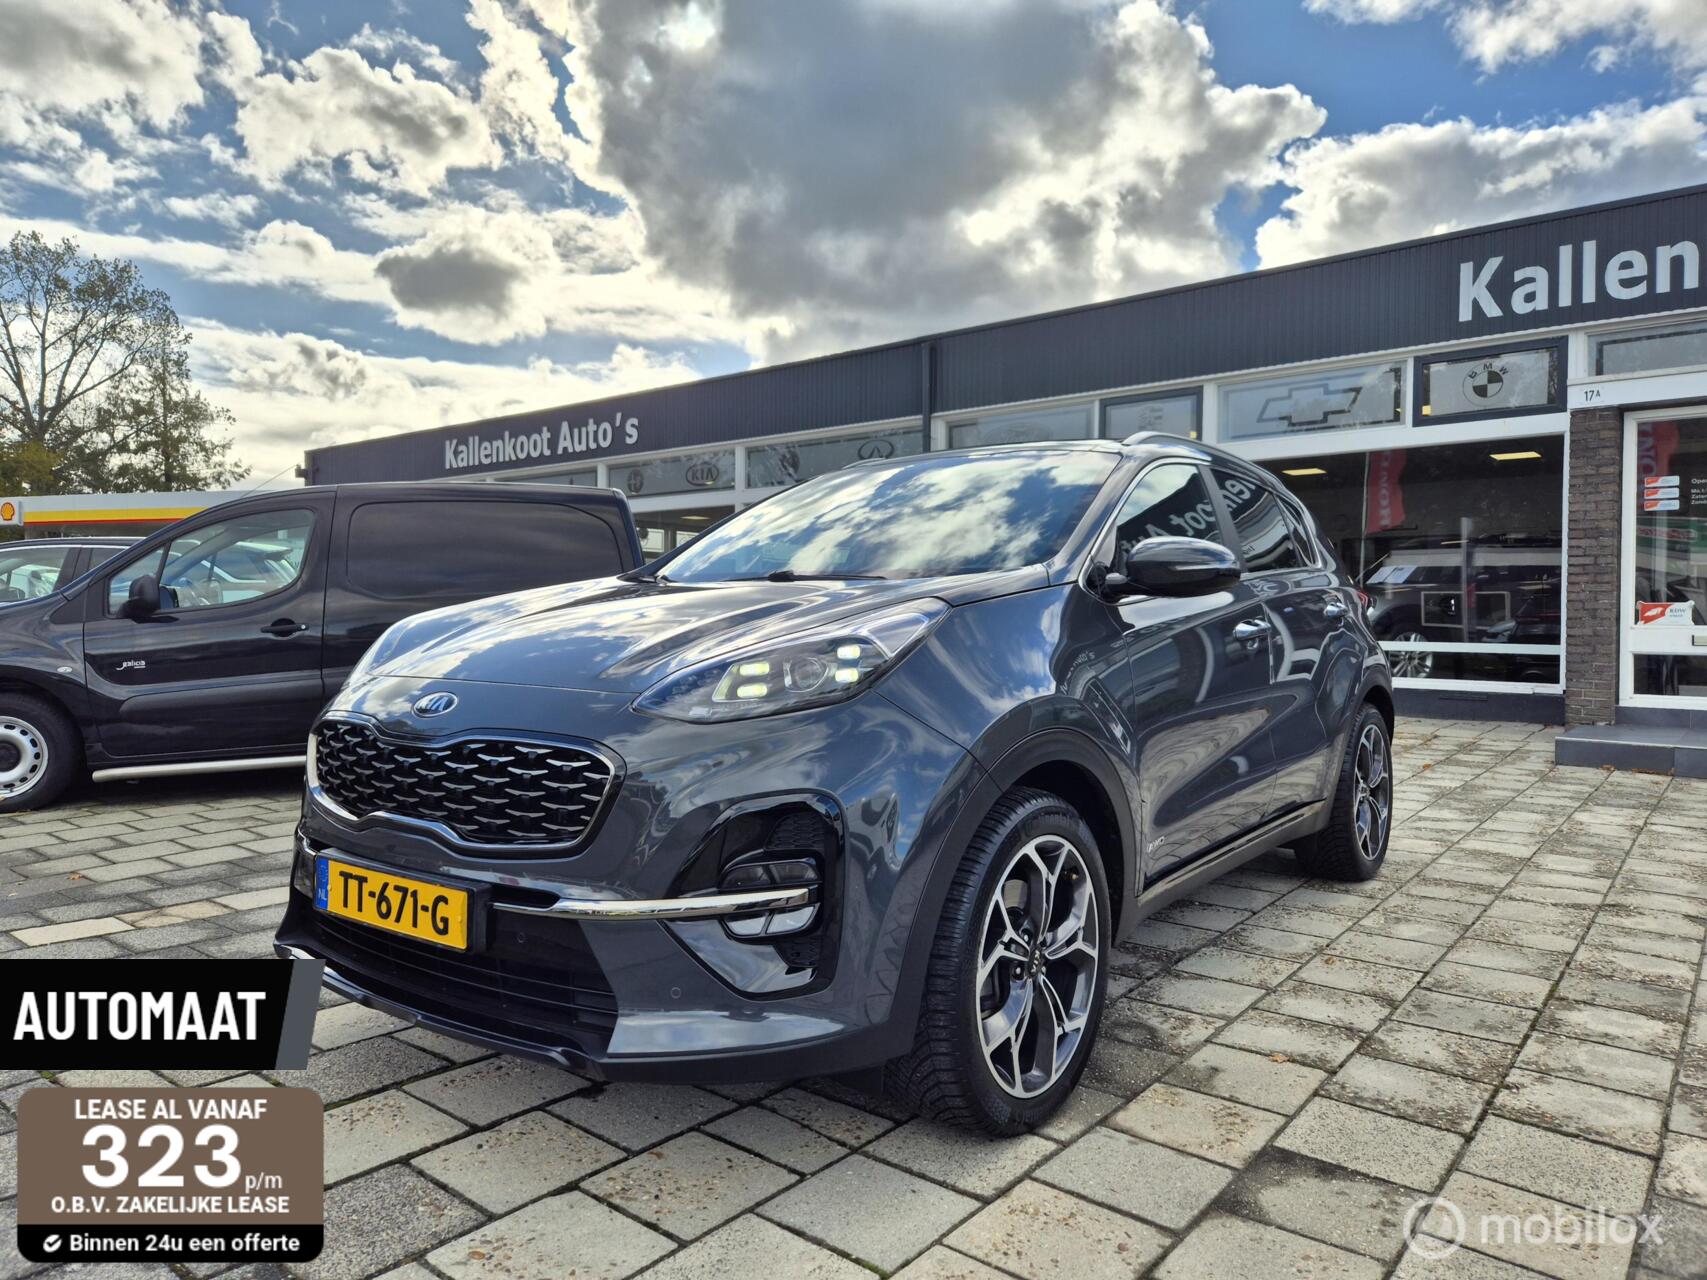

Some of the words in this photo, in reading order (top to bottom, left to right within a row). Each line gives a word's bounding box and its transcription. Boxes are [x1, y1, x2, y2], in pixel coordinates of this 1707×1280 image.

[1459, 240, 1700, 322] Kallen
[1468, 362, 1508, 380] BMW
[445, 425, 551, 469] Kallenkoot
[557, 412, 639, 455] Auto's
[692, 466, 714, 481] KIA
[417, 695, 449, 712] KIA
[318, 887, 328, 901] NL
[339, 870, 449, 936] TT-671-G
